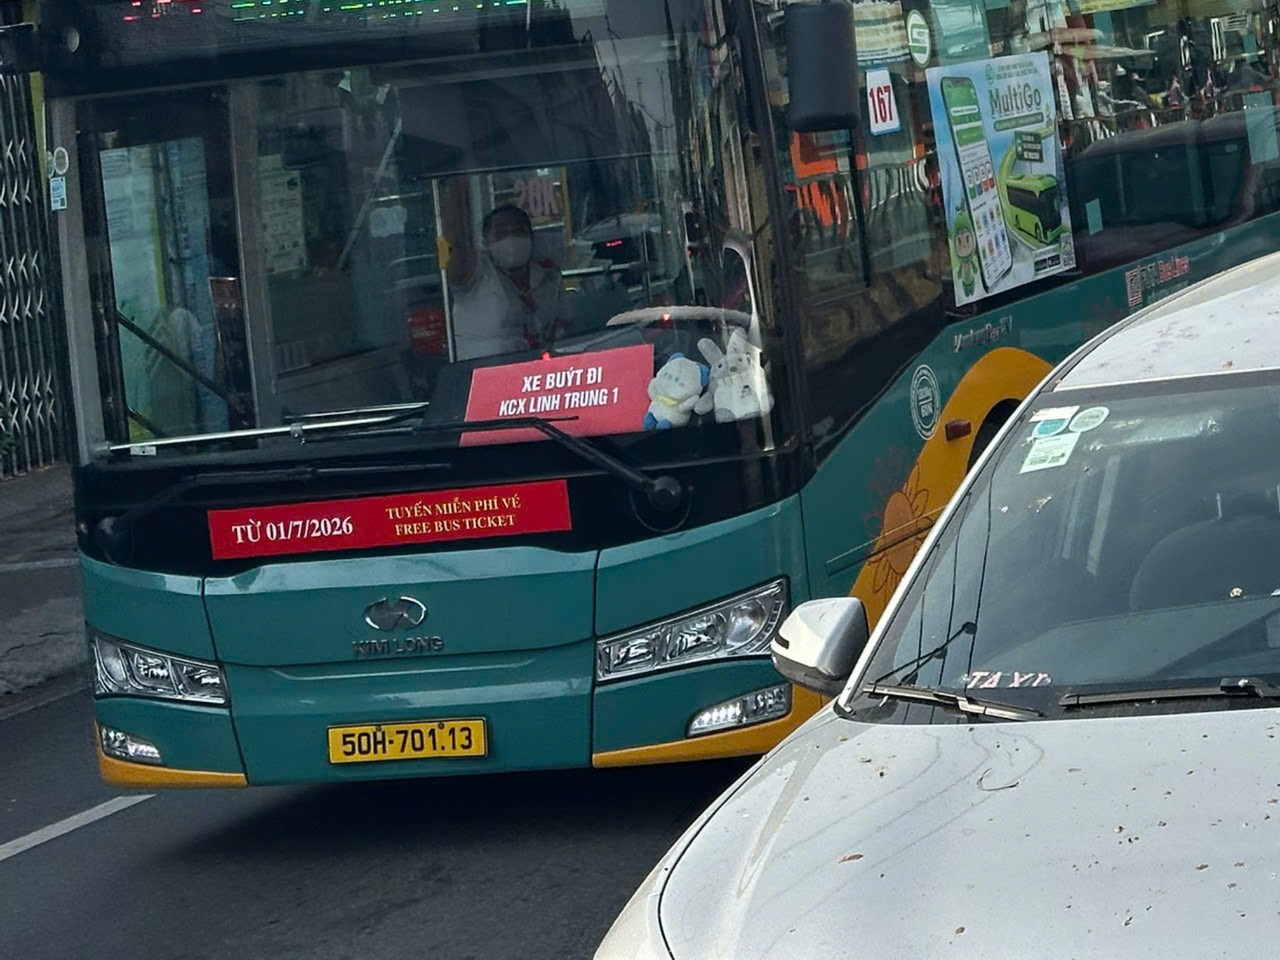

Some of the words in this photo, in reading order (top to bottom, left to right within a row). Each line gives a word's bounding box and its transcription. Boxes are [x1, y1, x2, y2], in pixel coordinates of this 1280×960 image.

[869, 85, 894, 125] 167
[988, 82, 1042, 116] MultiGo
[521, 375, 541, 393] XE
[545, 366, 584, 390] BUÝT
[586, 366, 603, 384] ĐI
[499, 398, 526, 417] KCX
[529, 393, 561, 414] LINH
[564, 389, 608, 410] TRUNG
[612, 387, 619, 404] 1
[385, 501, 433, 520] TUYẾN
[474, 495, 499, 512] PHÍ
[231, 518, 262, 544] TỪ
[265, 516, 354, 541] 01/7/2026
[395, 521, 432, 536] FREE
[434, 520, 461, 533] BUS
[462, 514, 516, 530] TICKET
[352, 639, 391, 657] KIM
[392, 635, 445, 654] LONG
[342, 726, 473, 757] 50H-701.13
